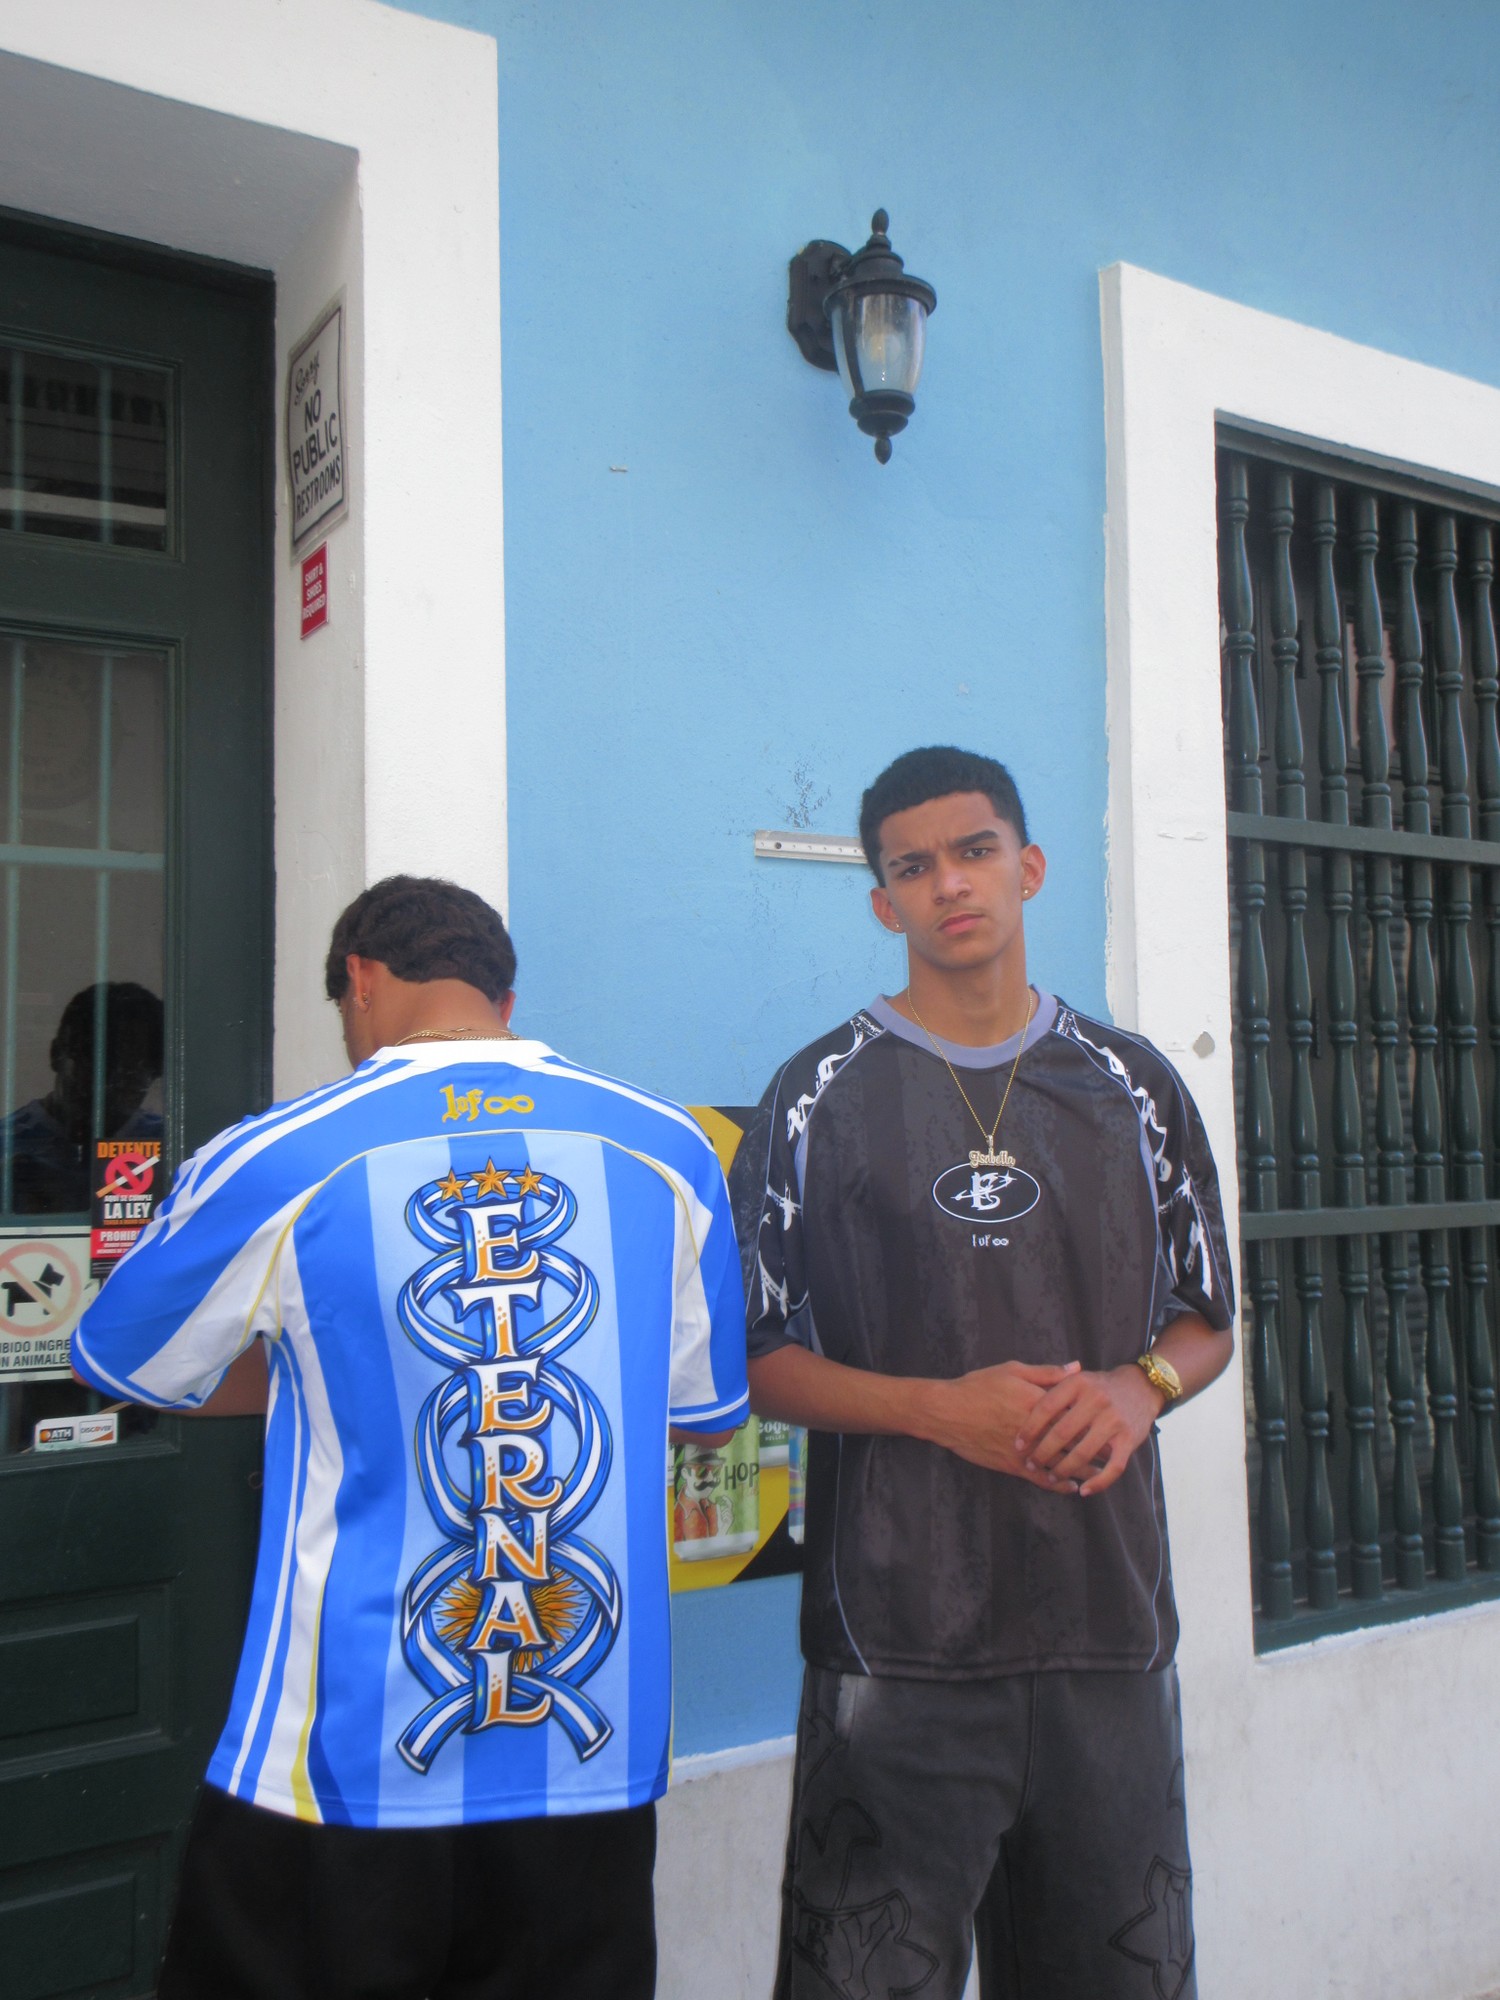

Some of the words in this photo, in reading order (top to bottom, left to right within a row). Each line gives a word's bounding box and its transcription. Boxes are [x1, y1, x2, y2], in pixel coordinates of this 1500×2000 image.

[304, 388, 321, 432] NO
[292, 412, 338, 485] PUBLIC
[295, 455, 341, 519] RESTROOMS
[97, 1141, 161, 1158] DETENTE
[104, 1203, 123, 1219] LA
[126, 1202, 152, 1219] LEY
[13, 1353, 72, 1367] ANIMALES
[51, 1428, 72, 1439] ATH
[80, 1425, 112, 1434] DISCOVER
[443, 1199, 564, 1735] ETERNAL
[724, 1462, 760, 1491] HOP
